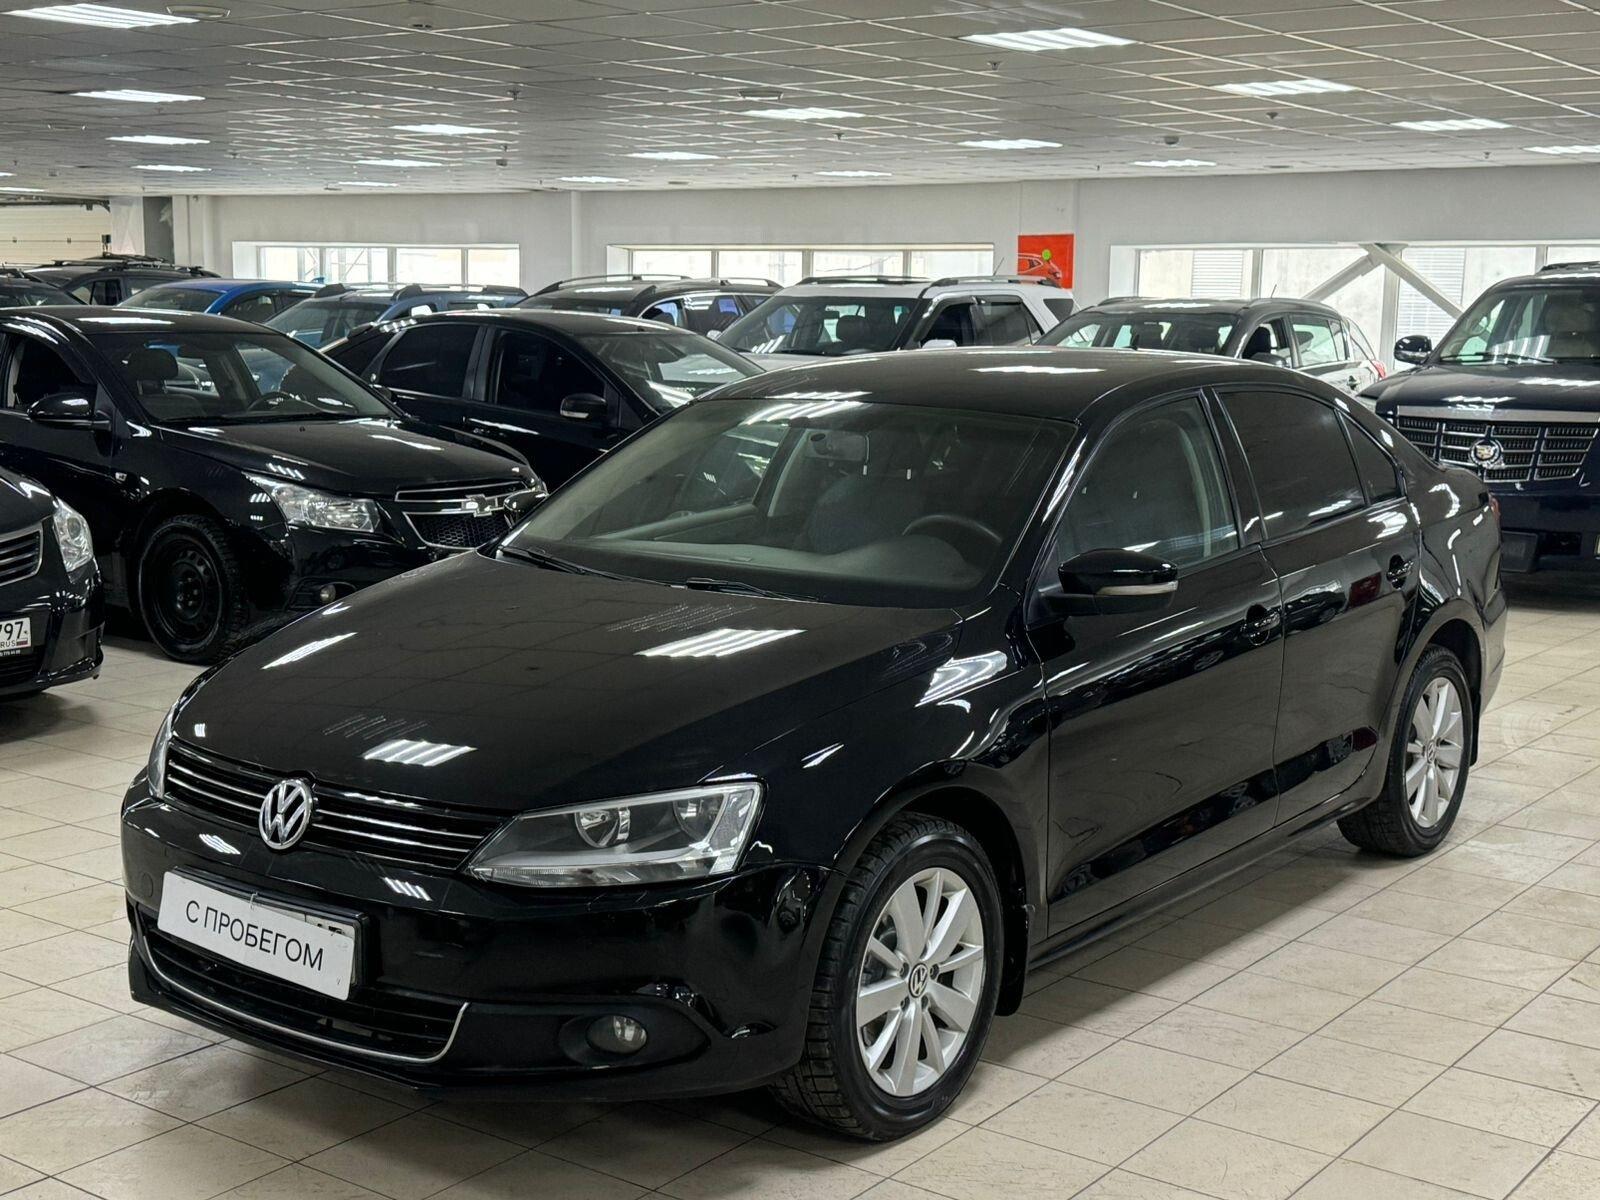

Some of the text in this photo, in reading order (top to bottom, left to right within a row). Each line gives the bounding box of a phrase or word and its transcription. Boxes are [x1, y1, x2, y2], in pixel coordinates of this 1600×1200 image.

[0, 621, 23, 640] 97
[186, 900, 323, 971] С ПРОБЕГОМ
